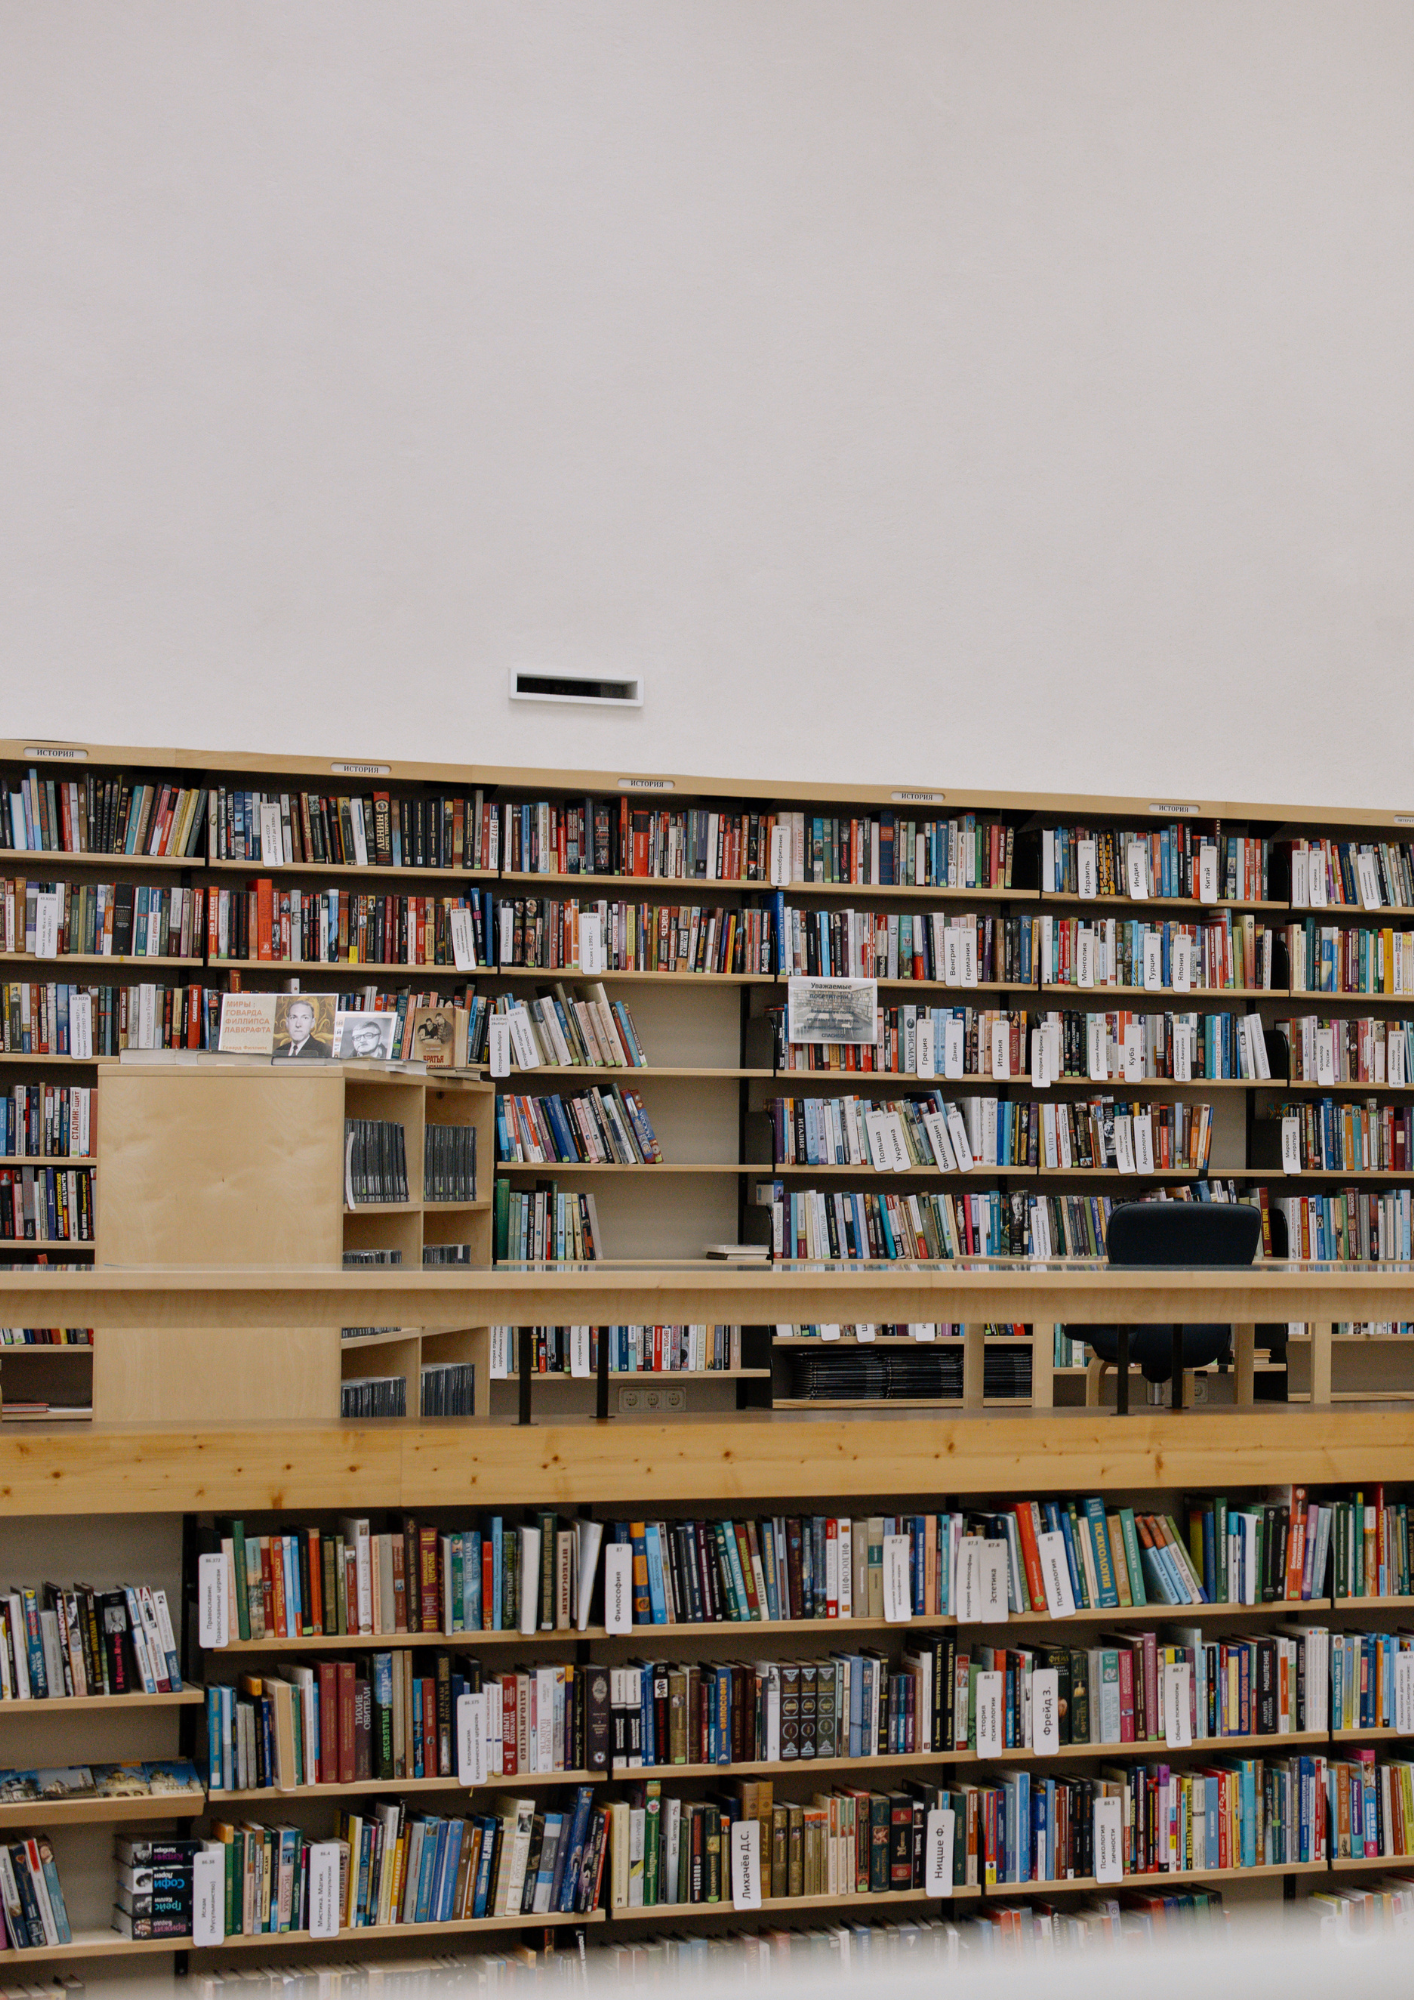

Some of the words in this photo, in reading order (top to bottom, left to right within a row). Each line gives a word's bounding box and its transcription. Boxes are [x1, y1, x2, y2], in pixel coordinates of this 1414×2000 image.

[37, 749, 74, 758] ИСТОРИЯ
[344, 765, 379, 774] ИСТОРИЯ
[630, 780, 664, 788] ИСТОРИЯ
[1158, 805, 1189, 813] ИСТОРИЯ
[376, 813, 385, 849] ЛЕНИН
[660, 909, 669, 936] ВЛАСТЬ
[1148, 953, 1156, 981] Турция
[810, 982, 852, 990] Уважаемые
[423, 1055, 444, 1064] БРАТЬЯ
[519, 1047, 529, 1067] История
[71, 1107, 79, 1140] СТАЛИН:
[875, 1131, 886, 1163] Польша
[889, 1129, 902, 1162] Украина
[933, 1125, 949, 1170] Финляндия
[956, 1130, 966, 1159] Франция
[1140, 1129, 1148, 1165] Археология
[465, 1542, 473, 1583] НЕБЕСНАЯ
[738, 1537, 751, 1571] ФИЛОСОФИИ
[765, 1532, 775, 1584] ФИЛОСОФИЯ
[1094, 1522, 1112, 1589] ПСИХОЛОГИЯ
[1125, 1520, 1138, 1569] ПСИХОЛОГИЯ
[428, 1551, 436, 1584] ЦЕРКОВЬ
[561, 1548, 569, 1615] ПРАВОСЛАВИЕ
[728, 1547, 744, 1595] ФИЛОСОФИЯ
[841, 1542, 850, 1594] ФИЛОСОФИЯ
[966, 1554, 974, 1591] философии
[1050, 1558, 1063, 1607] Психология
[276, 1580, 284, 1617] ВСТРЕЧАЕМ
[613, 1571, 623, 1622] Философия
[989, 1568, 998, 1604] Эстетика
[56, 1599, 68, 1646] MADONNA
[206, 1584, 214, 1630] Православие.
[215, 1595, 223, 1644] Православные
[35, 1651, 45, 1687] РЯЗАНОВ
[1263, 1649, 1271, 1691] МЫШЛЕНИЕ
[1334, 1664, 1342, 1707] ПРАЙМ-ТАЙМ
[381, 1668, 390, 1709] СВЯТЫЕ»
[719, 1677, 728, 1729] ФИЛОСОФИЯ
[1042, 1686, 1051, 1696] З.
[1173, 1683, 1181, 1719] психология
[355, 1694, 363, 1725] ТИХИЕ
[363, 1686, 371, 1730] ОБИТЕЛИ
[519, 1689, 527, 1761] КАТОЛИЧЕСТВО
[1042, 1698, 1053, 1735] Фрейд
[1104, 1689, 1112, 1738] ПСИХОЛОГИИ
[1241, 1702, 1249, 1731] СМЕРТИ
[382, 1709, 391, 1761] «НЕСВЯТЫЕ
[481, 1830, 493, 1860] ВАНГА
[594, 1829, 602, 1851] ЧИСЕЛ
[740, 1830, 751, 1853] Д.С.
[936, 1824, 946, 1838] Ф.
[1099, 1824, 1108, 1870] Психология
[153, 1871, 174, 1879] Лорен
[393, 1848, 403, 1897] НУМЕРОЛОГИЯ
[591, 1854, 599, 1878] ТАЙНЫ
[739, 1854, 751, 1900] Лихачёв
[934, 1840, 946, 1879] Ницше
[153, 1878, 186, 1890] Софи
[282, 1874, 291, 1913] ИСЛАМА
[317, 1871, 325, 1895] Магия.
[154, 1900, 182, 1913] Грейс
[208, 1880, 217, 1934] (Мусульманство)
[153, 1924, 187, 1933] Брижит
